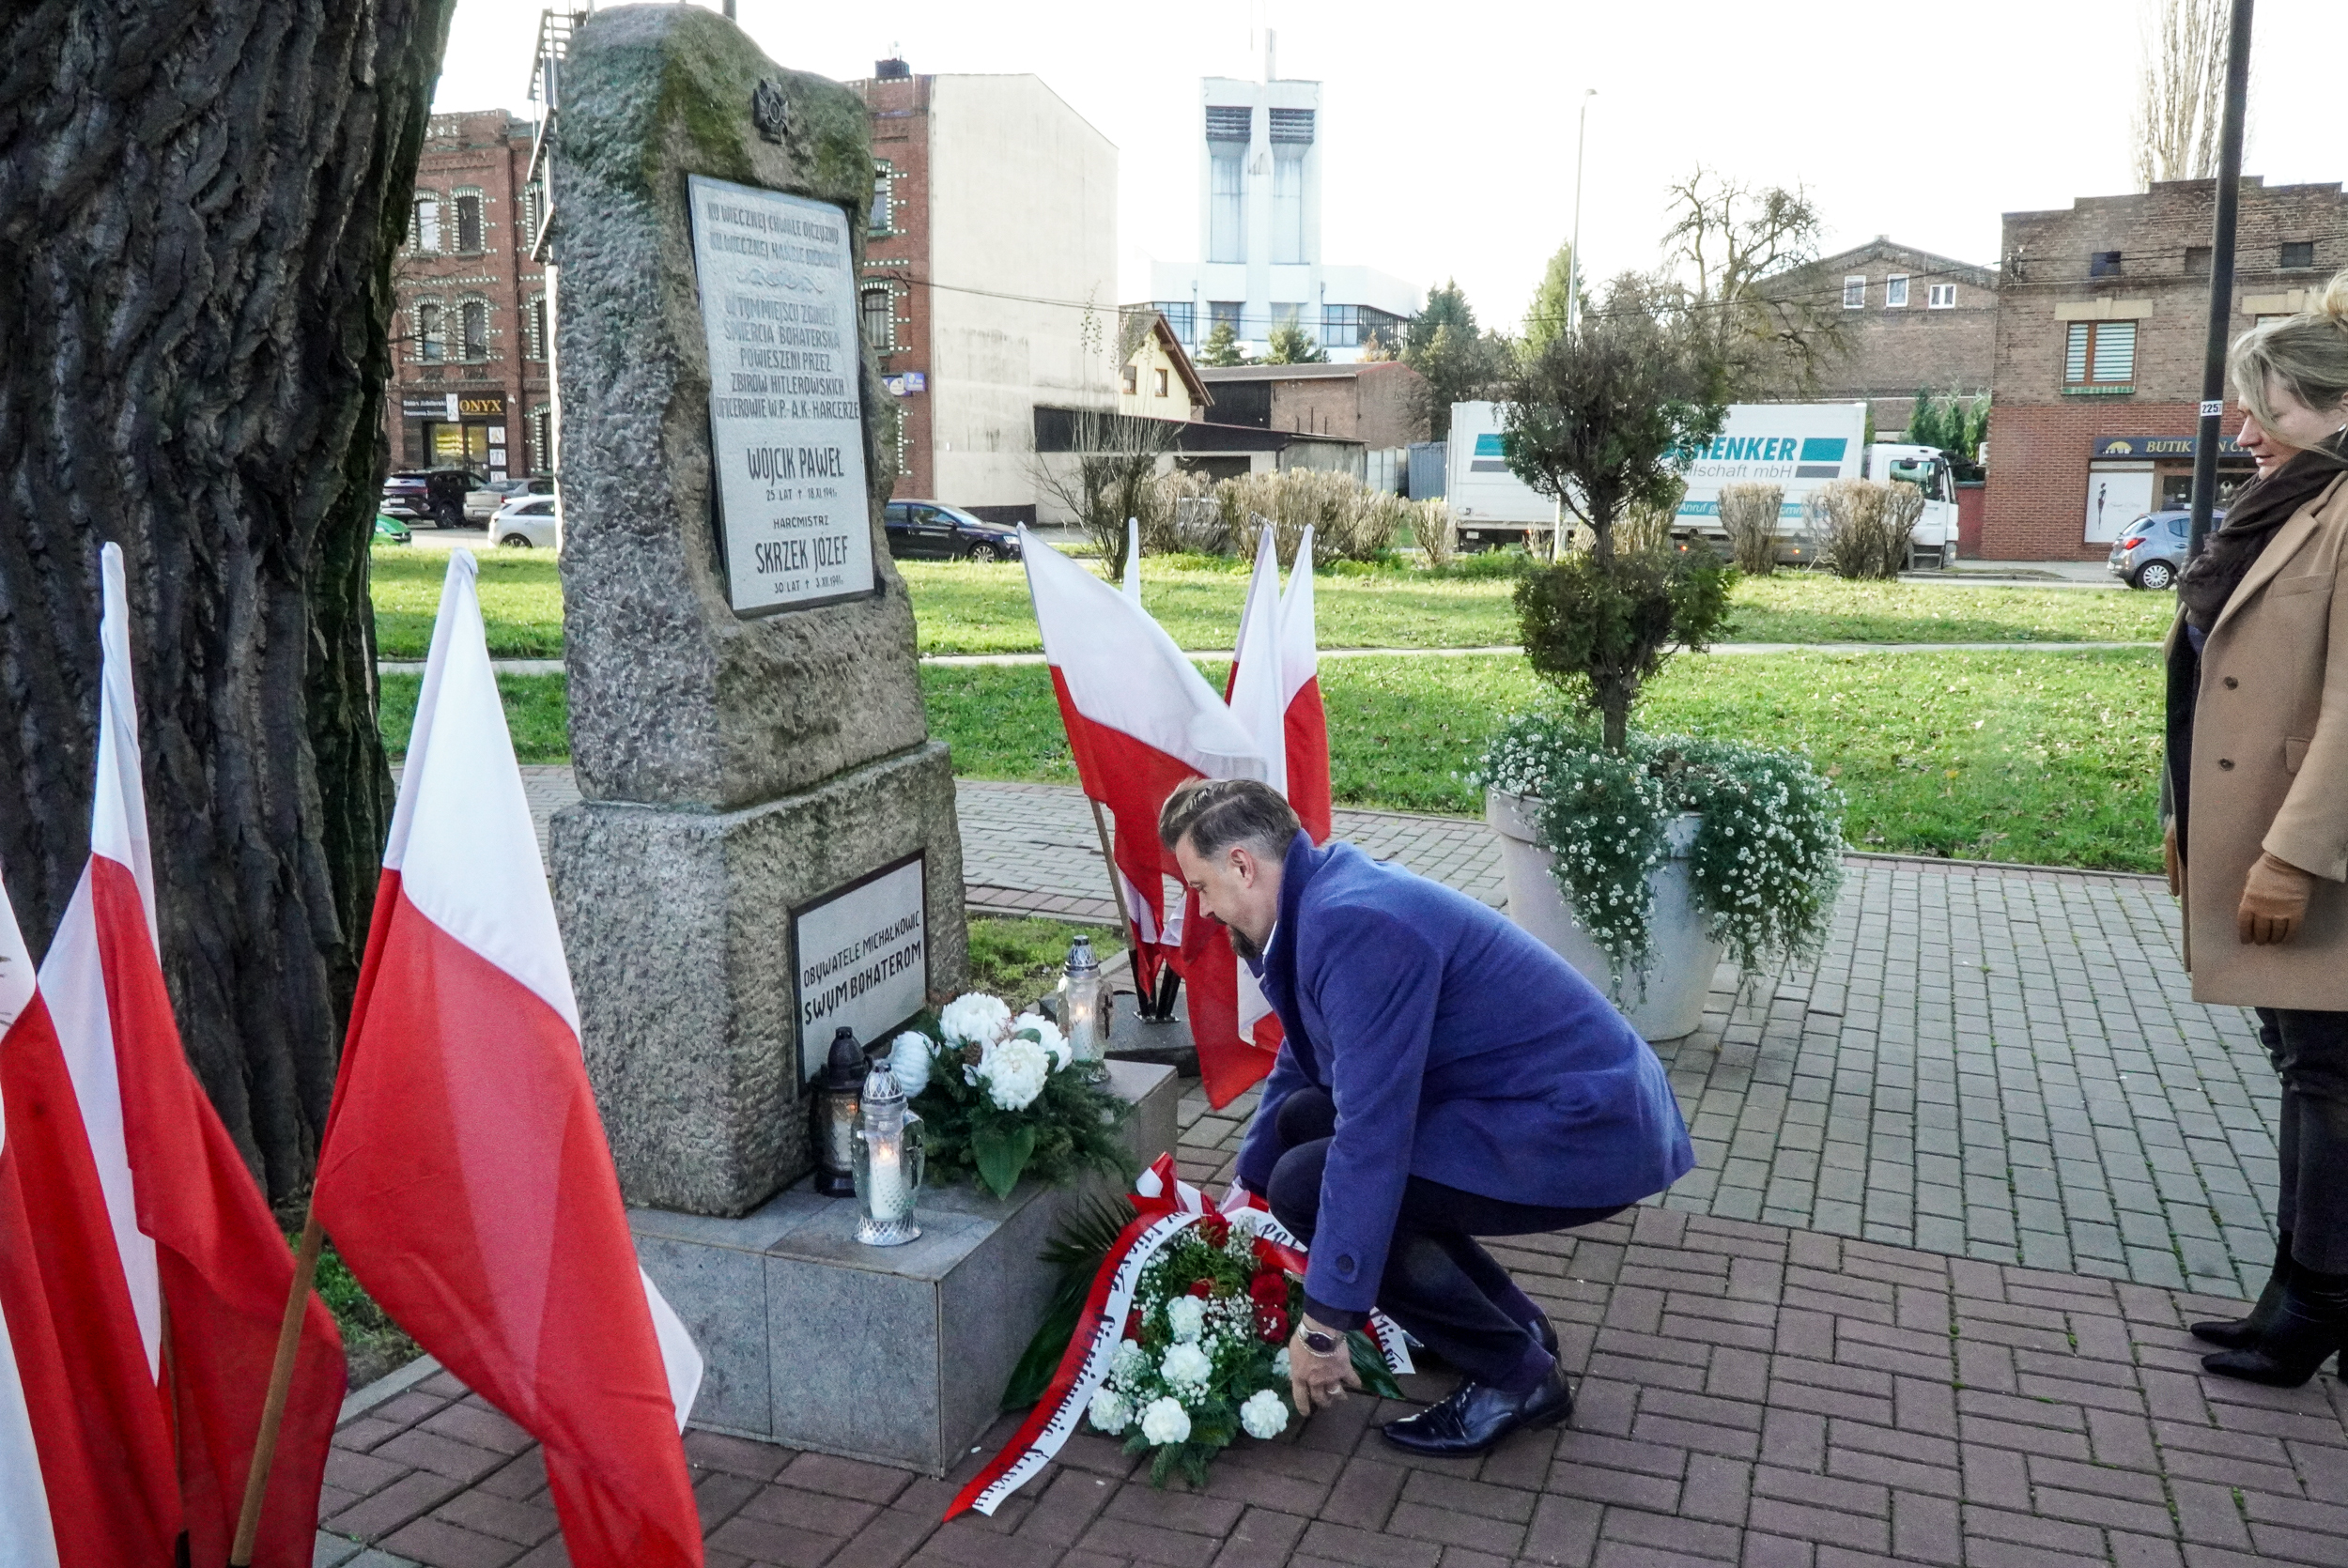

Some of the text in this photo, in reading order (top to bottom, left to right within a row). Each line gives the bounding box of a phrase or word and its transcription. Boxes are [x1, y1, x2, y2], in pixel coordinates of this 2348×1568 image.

[707, 202, 719, 222] KU
[721, 205, 766, 234] WIECZNEJ
[737, 296, 761, 319] TYM
[761, 299, 799, 324] MIEJSCU
[740, 346, 831, 373] POWIESZENI PRZEZ
[770, 375, 844, 396] HITLEROWSKICH
[459, 399, 502, 411] ONYX
[715, 396, 766, 419] OFICEROWIE
[812, 401, 859, 420] HARCERZE
[2146, 440, 2192, 453] BUTIK
[747, 440, 844, 487] WÓJCIK PAWEŁ
[1753, 465, 1793, 479] mbH
[766, 489, 776, 501] 25
[779, 488, 793, 500] LAT
[1678, 502, 1707, 514] Anruf
[773, 515, 829, 530] HARCMISTRZ
[755, 531, 848, 575] SKRZEK JÓZEF
[775, 581, 784, 593] 30
[786, 580, 800, 592] LAT
[803, 942, 860, 988] OBYWATELE
[804, 940, 921, 1025] SWYM BOHATEROM
